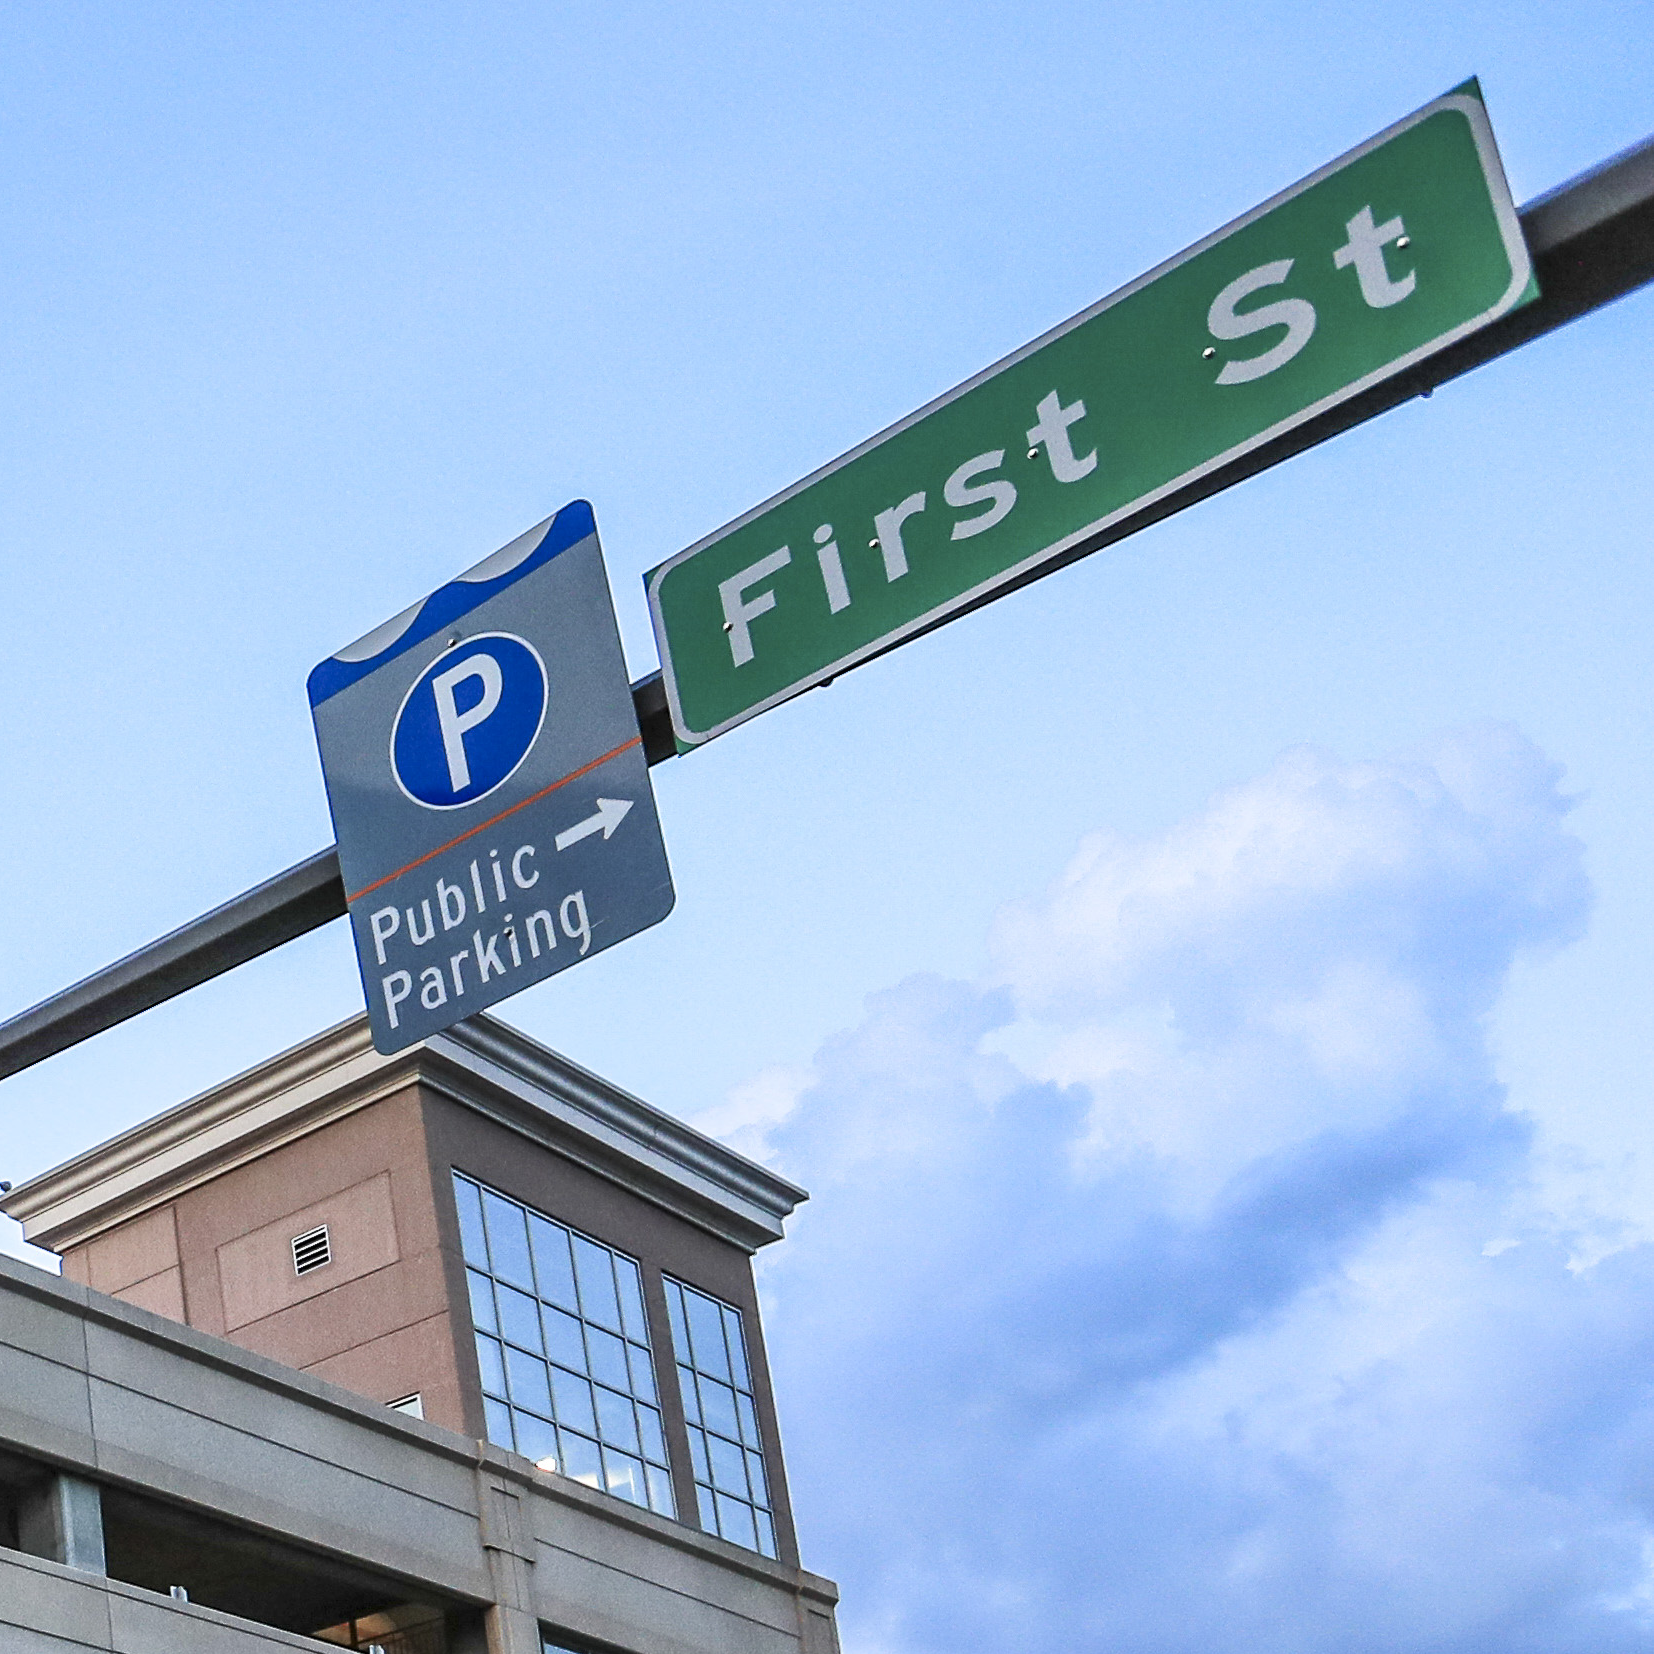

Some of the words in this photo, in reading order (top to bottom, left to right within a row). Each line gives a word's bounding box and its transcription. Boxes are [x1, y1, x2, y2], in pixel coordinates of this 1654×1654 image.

[718, 389, 1097, 668] First
[1207, 204, 1417, 386] St
[432, 652, 503, 793] P
[370, 844, 540, 965] Public
[382, 890, 592, 1029] Parking
